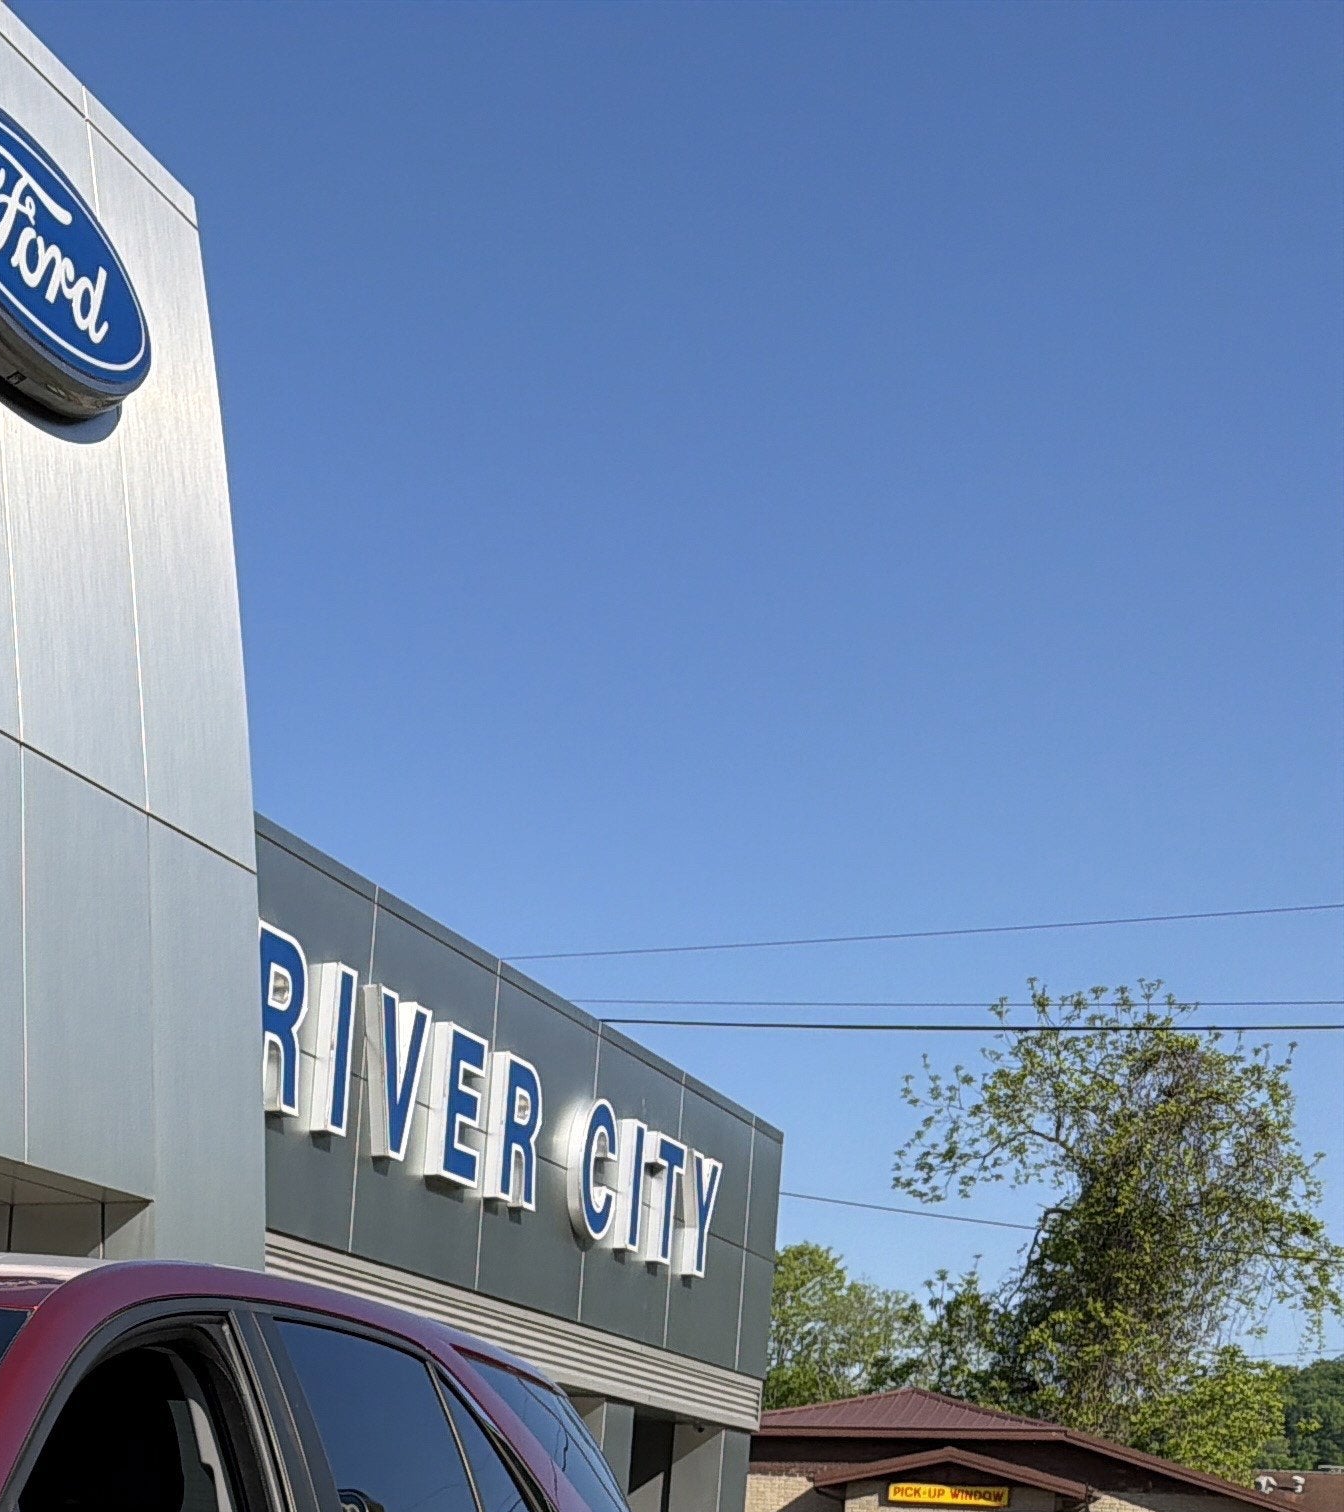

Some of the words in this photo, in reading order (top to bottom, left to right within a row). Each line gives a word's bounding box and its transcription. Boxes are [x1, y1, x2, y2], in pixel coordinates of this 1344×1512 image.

[259, 917, 543, 1212] RIVER
[568, 1097, 723, 1279] CITY
[892, 1486, 946, 1499] PICK-UP
[950, 1487, 1004, 1502] WINDOW
